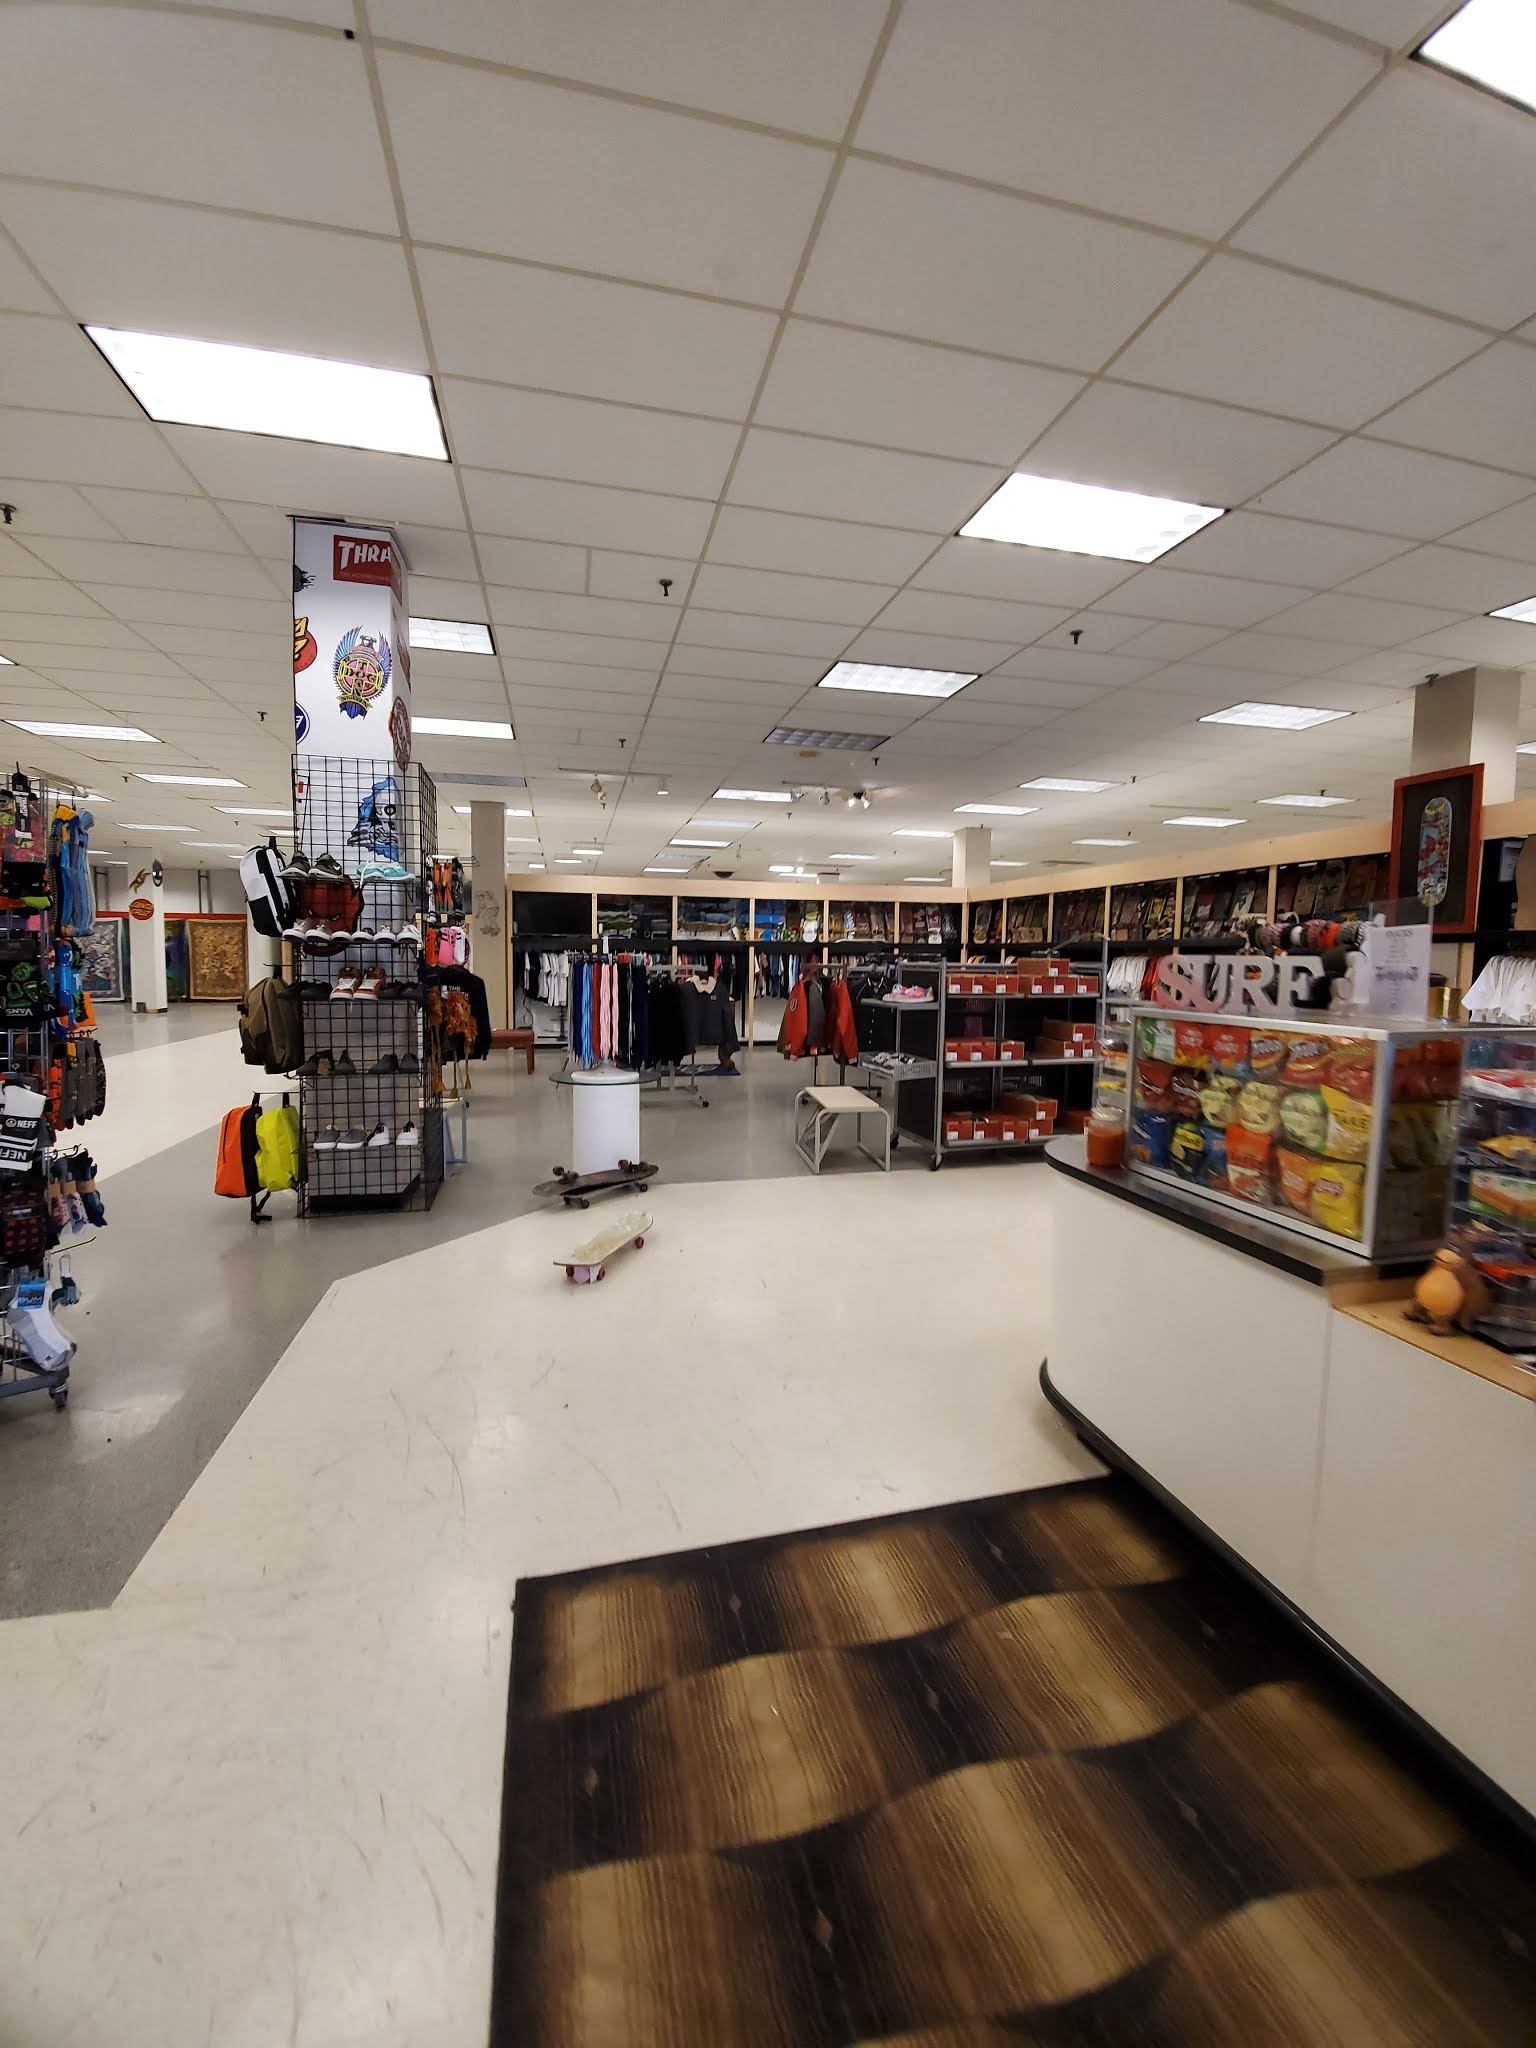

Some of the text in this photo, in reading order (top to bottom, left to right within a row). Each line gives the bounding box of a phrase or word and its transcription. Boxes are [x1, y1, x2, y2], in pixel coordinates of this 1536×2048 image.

[1156, 953, 1326, 1013] SURF
[5, 1008, 34, 1017] VANS
[16, 1119, 38, 1129] NEFF
